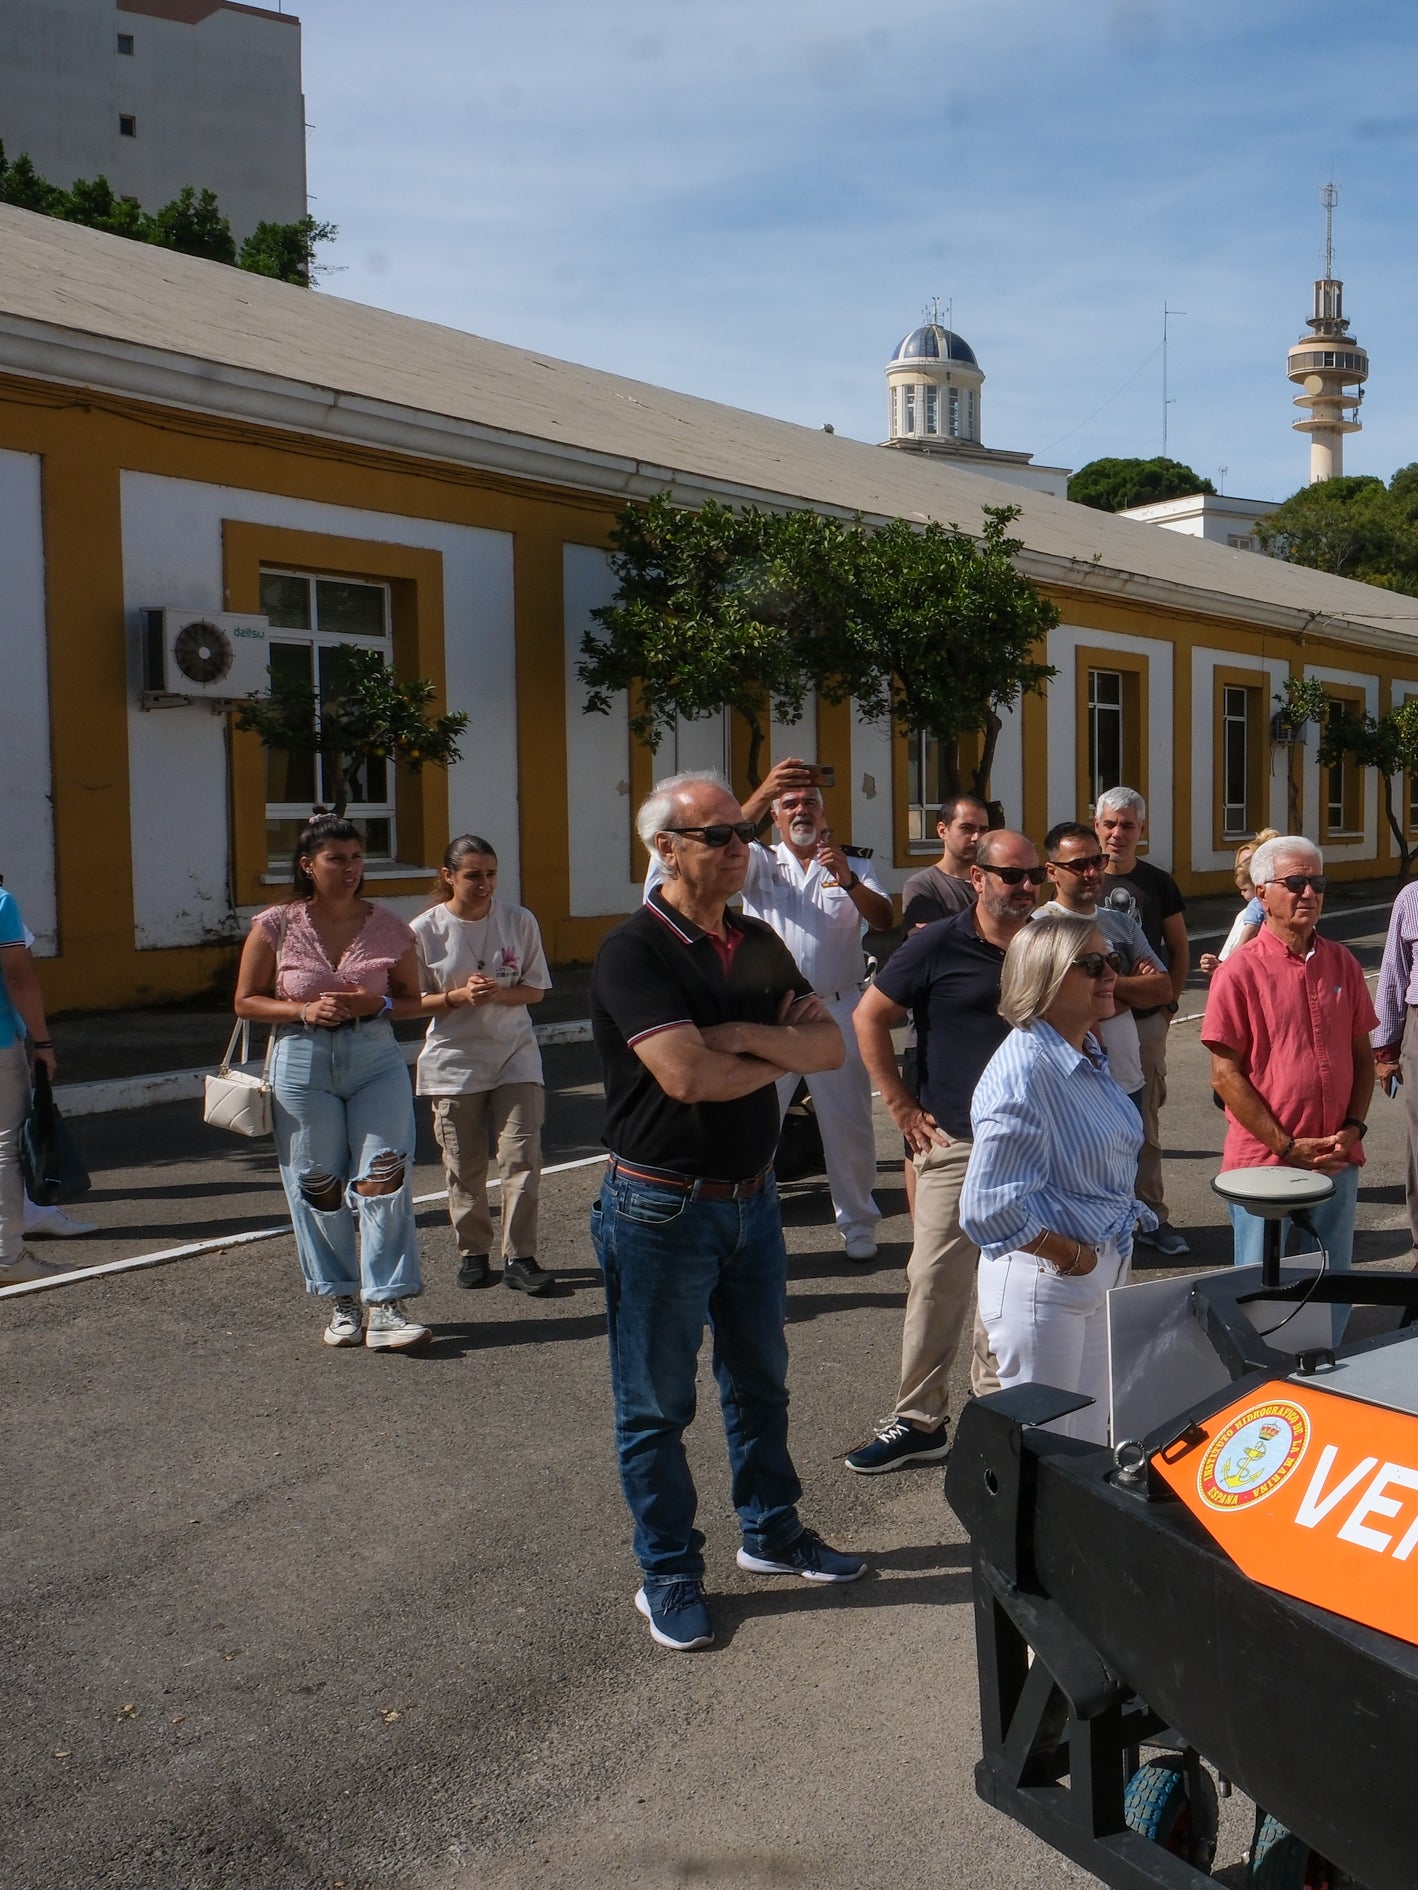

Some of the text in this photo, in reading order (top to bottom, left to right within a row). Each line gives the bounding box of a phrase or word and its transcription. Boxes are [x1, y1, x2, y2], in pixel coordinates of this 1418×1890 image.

[1293, 1422, 1304, 1436] DE
[1204, 1429, 1234, 1481] INSTITUTO
[1290, 1439, 1302, 1453] LA
[1252, 1456, 1293, 1497] MARINA
[1207, 1486, 1238, 1504] ESPAÑA
